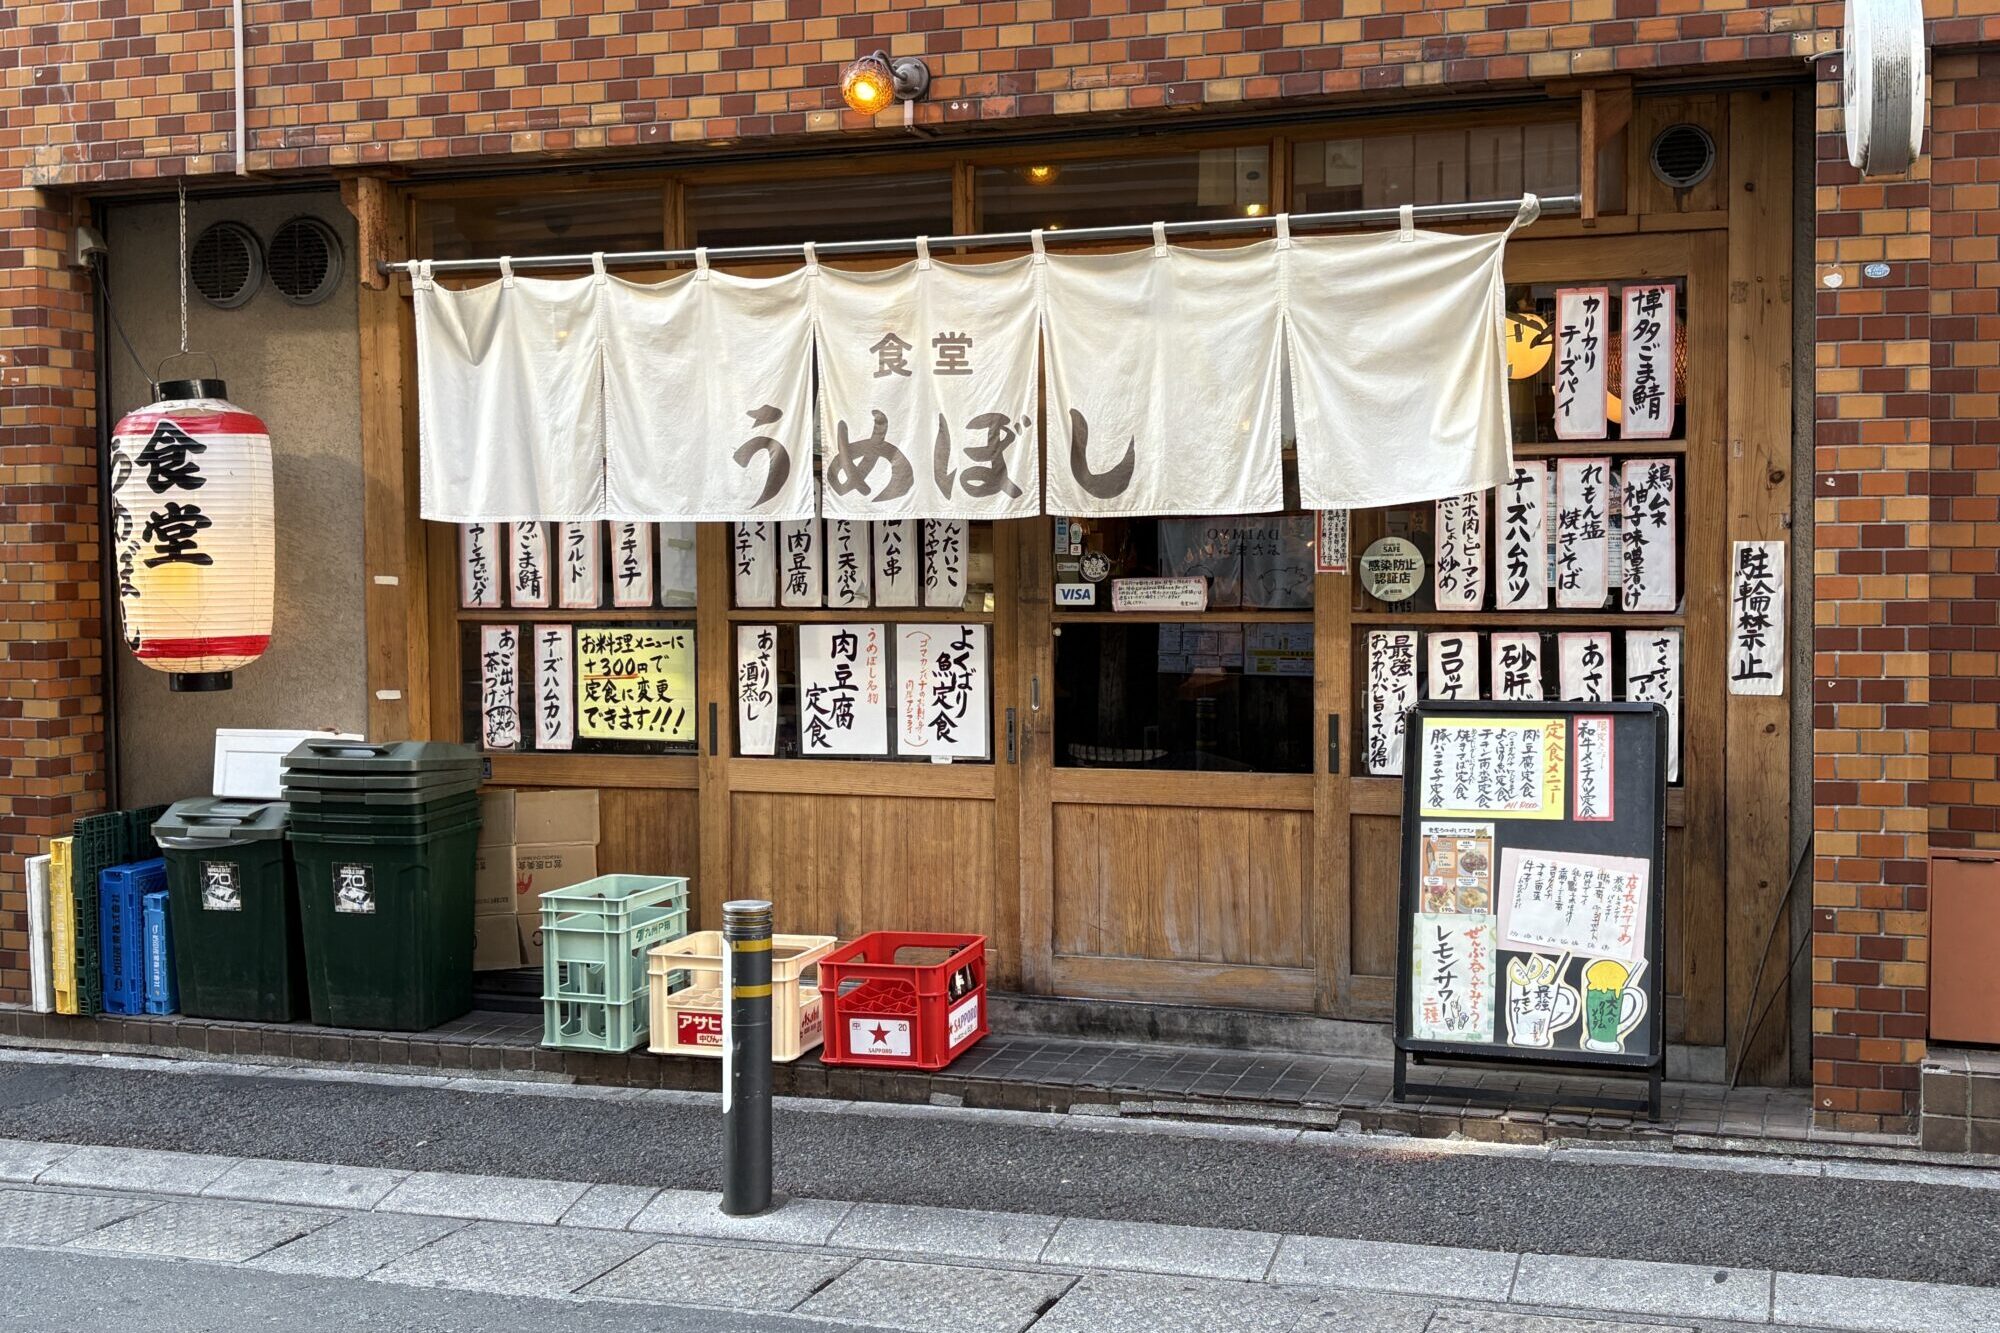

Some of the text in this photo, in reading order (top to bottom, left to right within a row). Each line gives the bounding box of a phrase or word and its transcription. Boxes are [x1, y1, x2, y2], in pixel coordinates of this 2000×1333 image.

[869, 331, 974, 378] 食堂
[1558, 325, 1582, 416] チーズパイ
[1581, 295, 1600, 373] カリカリ
[1629, 286, 1665, 421] 博多ごま鯖
[733, 404, 1136, 509] うめぼし
[134, 420, 214, 567] 食堂
[1580, 463, 1606, 541] れもん塩
[1646, 462, 1674, 529] 鶏ムネ
[566, 521, 586, 584] ラルド
[785, 519, 812, 596] 肉豆腐
[1368, 558, 1417, 571] 感染防止
[1505, 468, 1536, 606] チーズハムカツ
[1558, 507, 1583, 590] 焼きそば
[1060, 588, 1091, 600] VISA
[1374, 571, 1411, 584] 認証店
[1731, 546, 1776, 681] 駐輪禁止
[484, 651, 500, 707] 茶づけ
[498, 627, 516, 703] あご出汁
[581, 632, 685, 656] お料理メニューに
[757, 629, 773, 707] あさりの
[828, 628, 859, 730] 肉豆腐
[950, 625, 977, 718] よくばり
[1499, 643, 1537, 700] 砂肝
[542, 631, 563, 740] チーズハムカツ
[584, 676, 674, 704] 定食に変更
[740, 661, 759, 721] 酒蒸し
[803, 681, 833, 748] 定食
[928, 651, 959, 744] 魚定食
[1370, 634, 1389, 768] おかわりが旨くてお得
[1519, 728, 1538, 798] 肉豆腐定食
[1545, 720, 1564, 805] 定食メニュー
[208, 872, 231, 884] 70
[340, 874, 364, 886] 70
[1432, 925, 1460, 1018] レモンサワー
[1521, 985, 1533, 1015] レモン
[1533, 985, 1553, 1012] 最強
[898, 1023, 908, 1032] 20
[954, 1005, 977, 1033] SAPPORO
